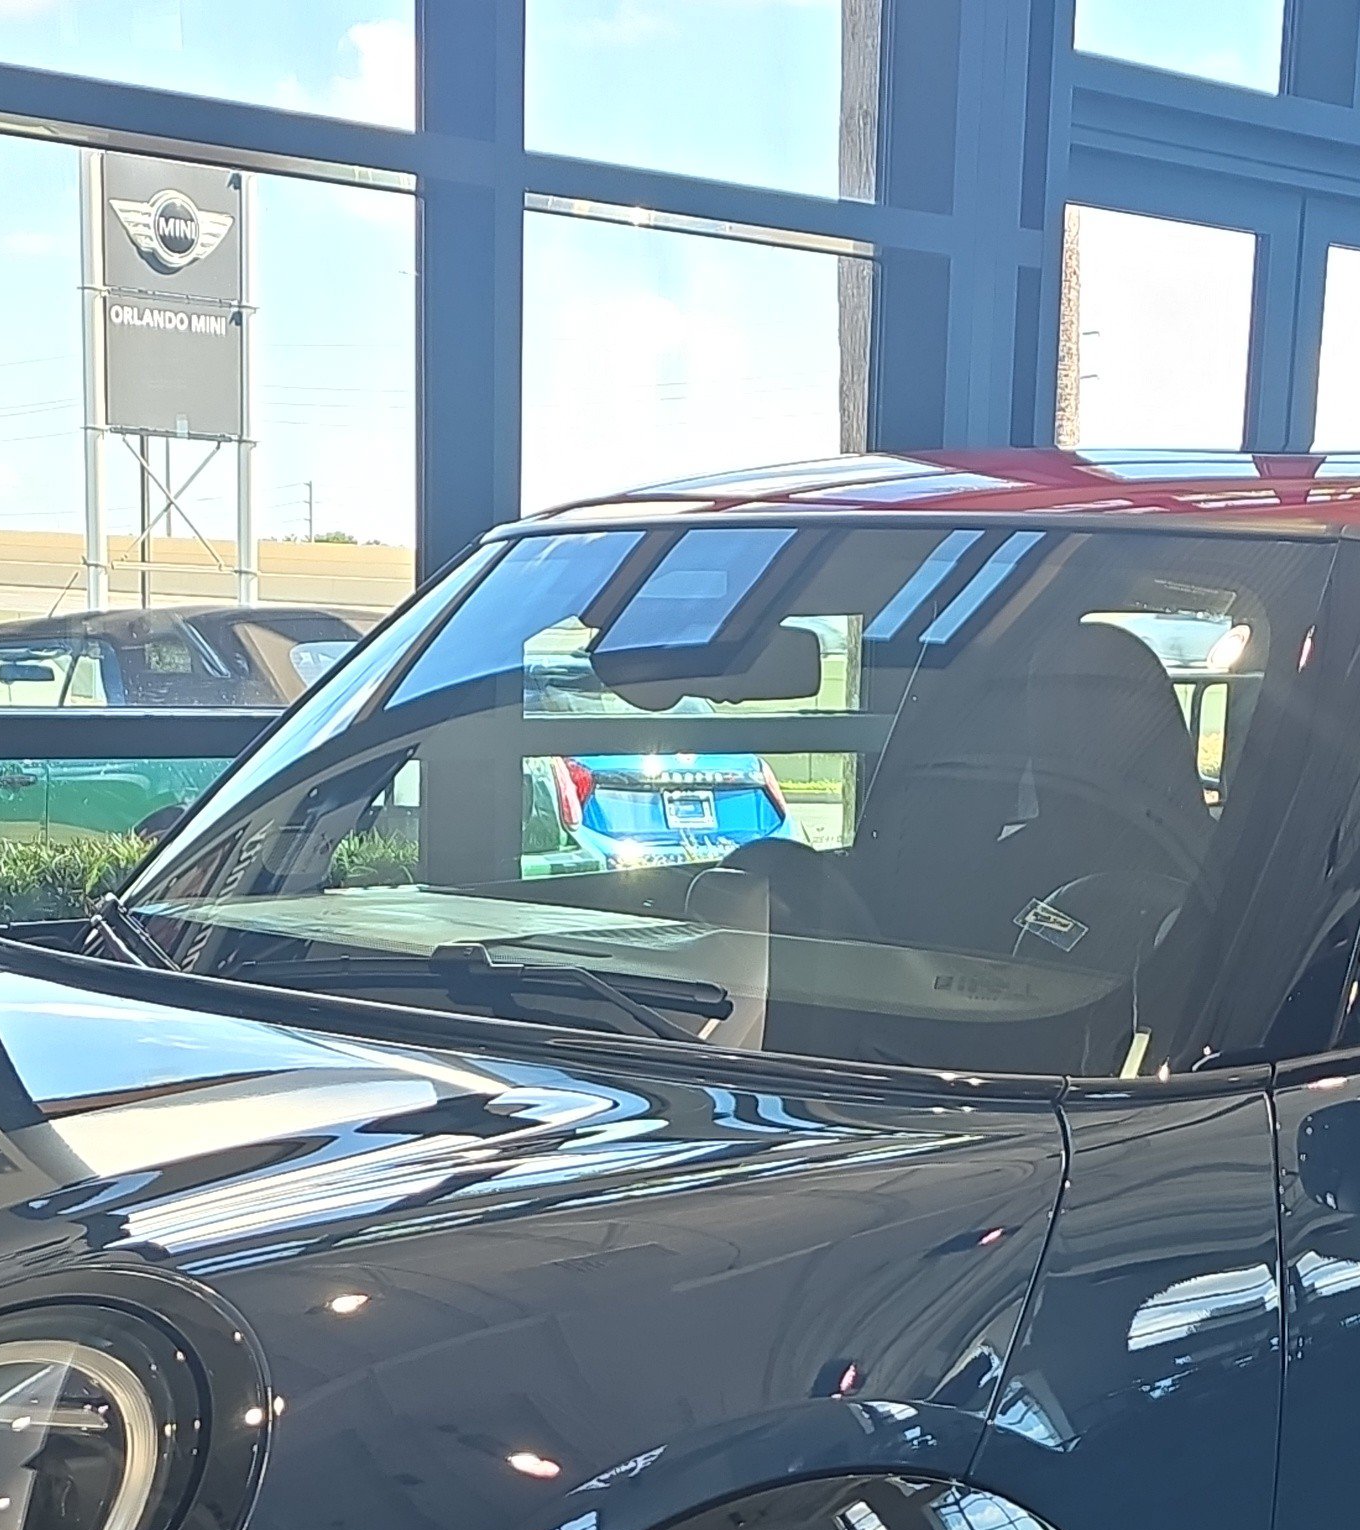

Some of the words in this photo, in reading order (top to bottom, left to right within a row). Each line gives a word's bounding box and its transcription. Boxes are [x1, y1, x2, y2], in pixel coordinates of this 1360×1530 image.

[158, 217, 197, 241] MINI
[109, 304, 189, 331] ORLANDO
[191, 314, 226, 337] MINI
